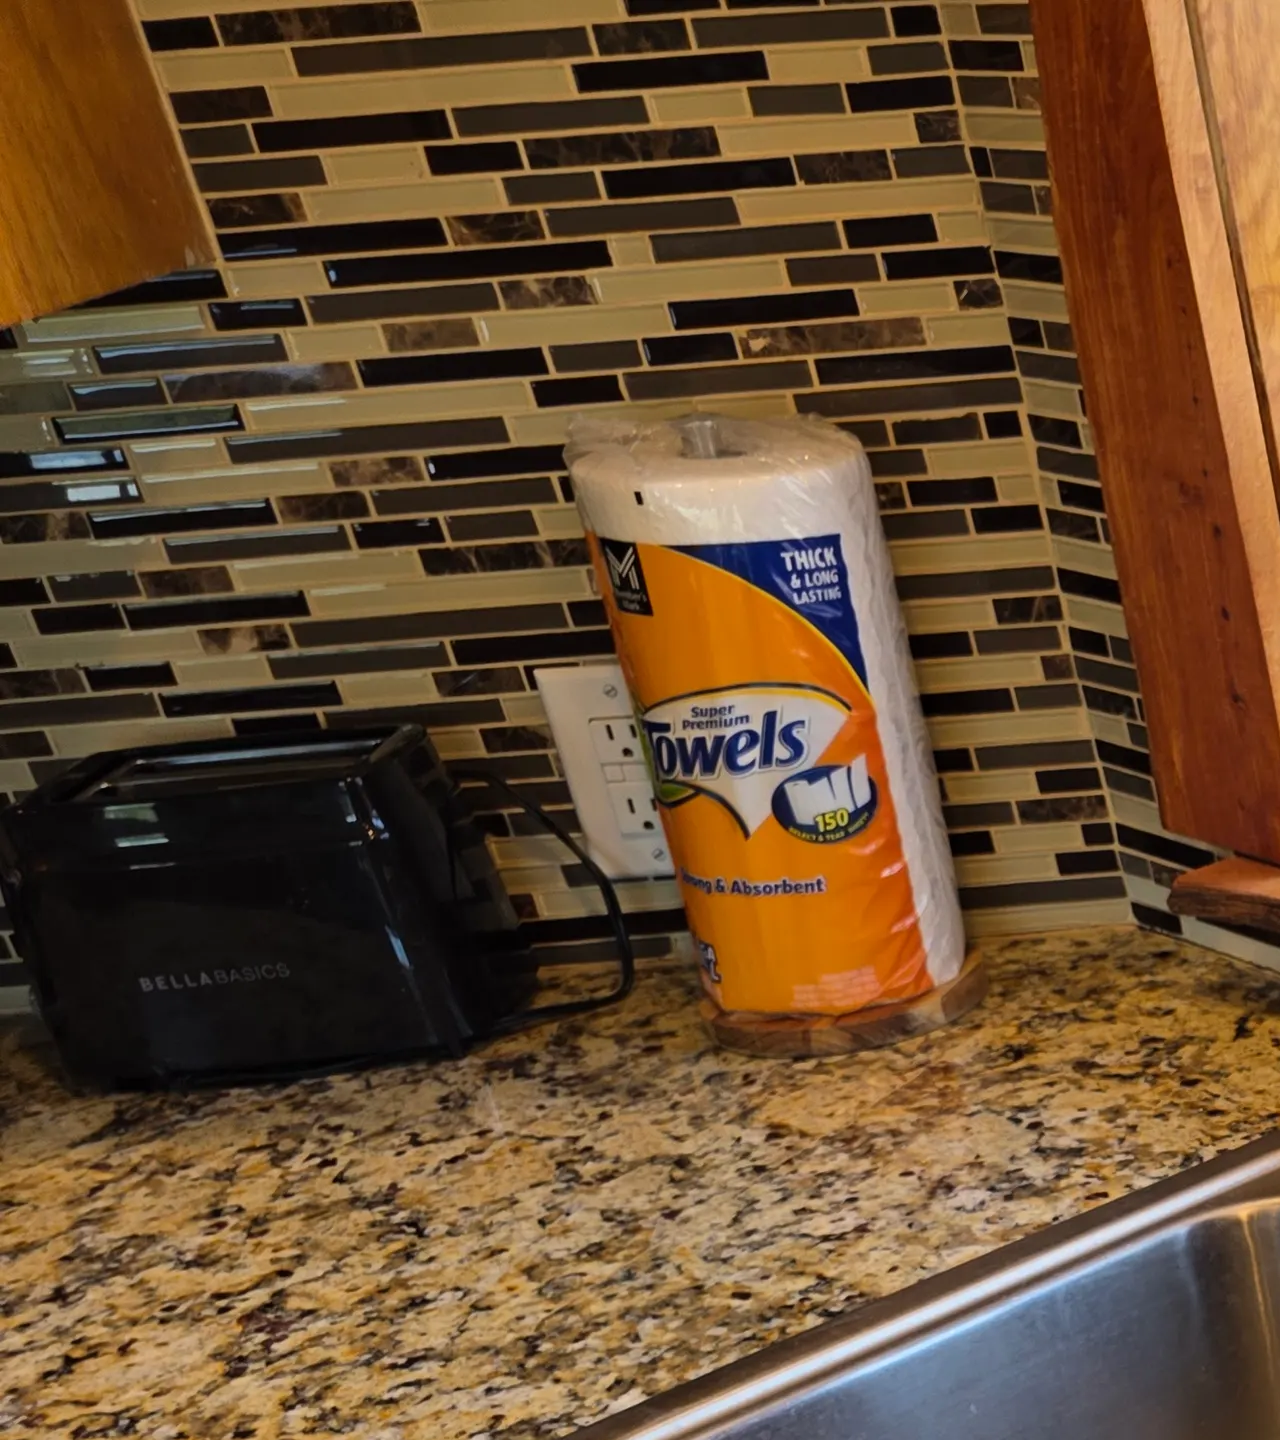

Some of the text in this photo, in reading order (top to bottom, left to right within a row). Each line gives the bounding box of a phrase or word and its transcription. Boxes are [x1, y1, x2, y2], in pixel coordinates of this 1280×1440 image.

[780, 546, 837, 571] THICK
[790, 568, 839, 589] & LONG
[792, 585, 842, 605] LASTING
[690, 704, 735, 719] Super
[682, 714, 750, 731] Premium
[641, 709, 807, 779] Towels
[814, 807, 849, 833] 150
[715, 877, 726, 894] &
[731, 877, 825, 896] Absorbent
